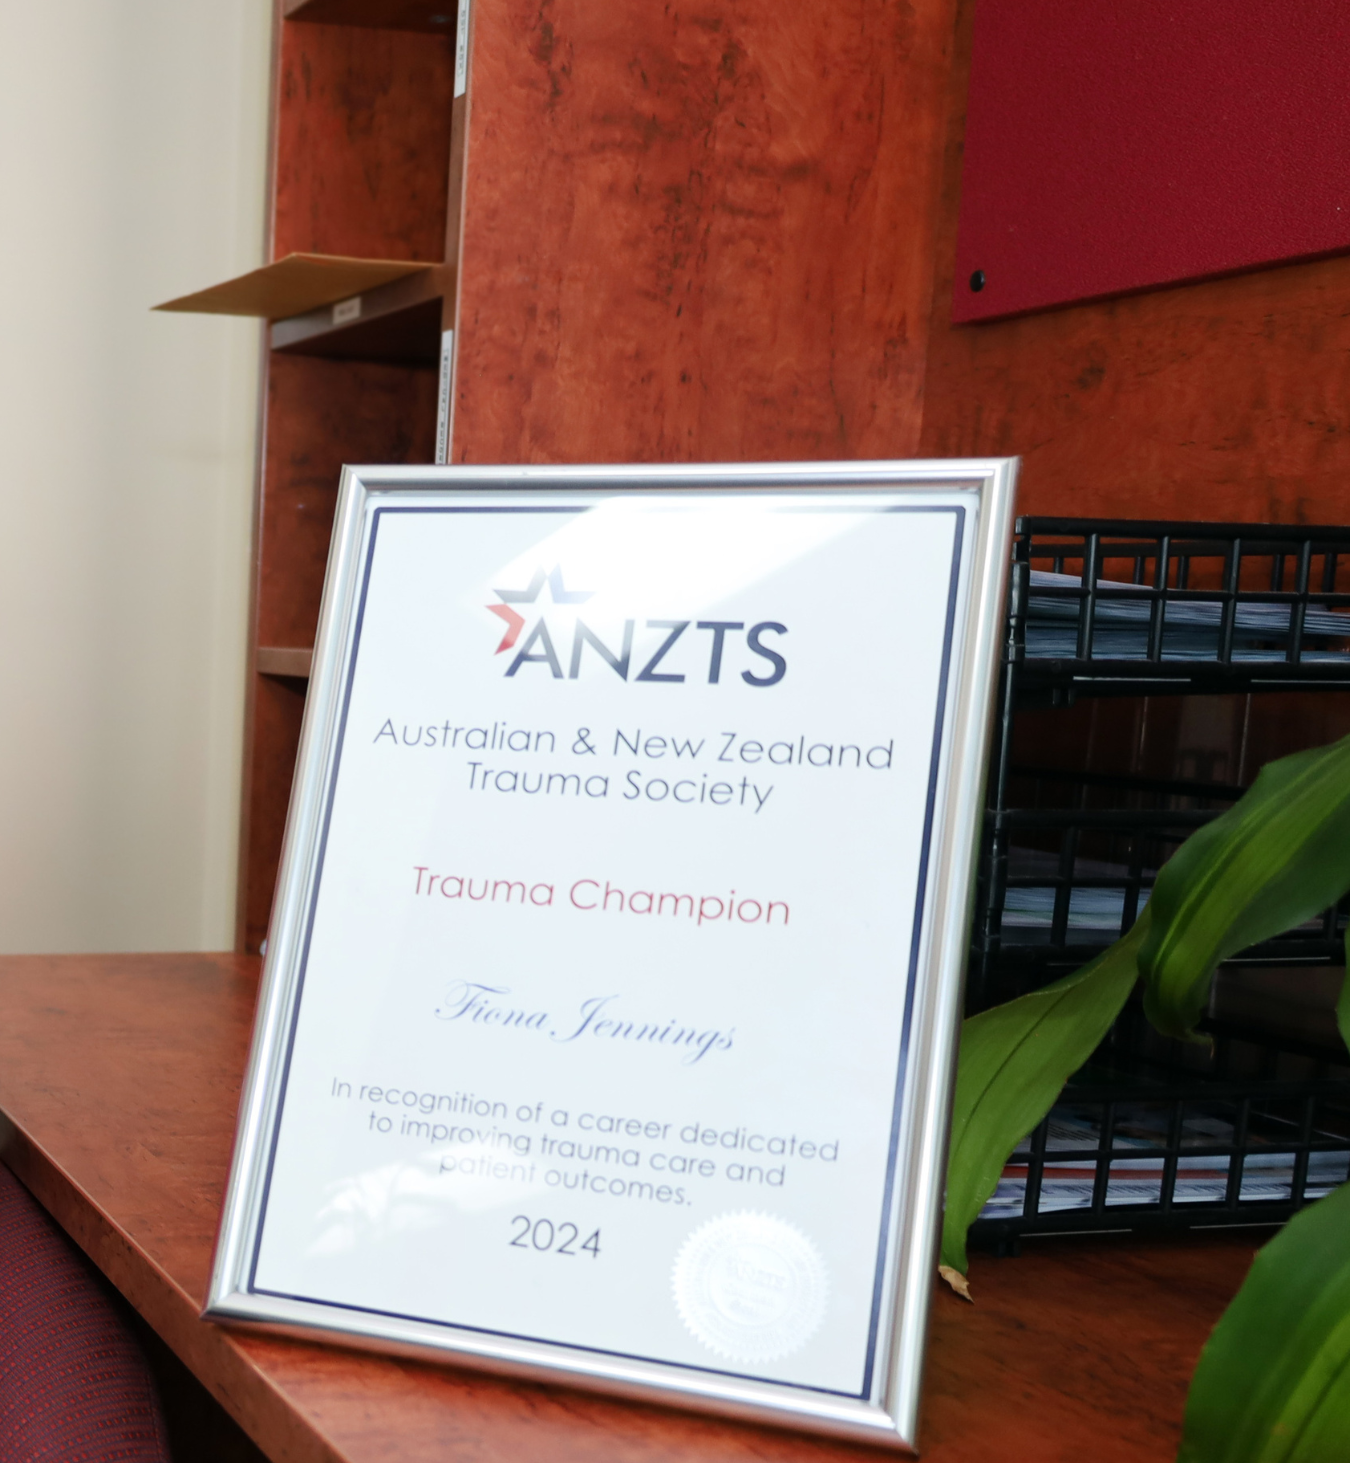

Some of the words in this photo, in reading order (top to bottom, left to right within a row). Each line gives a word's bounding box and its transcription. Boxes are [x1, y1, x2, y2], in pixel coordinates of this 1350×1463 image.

[503, 615, 789, 688] ANZTS
[373, 717, 556, 753] Australian
[571, 727, 597, 756] &
[613, 728, 706, 760] New
[717, 732, 895, 770] Zealand
[467, 761, 610, 798] Trauma
[622, 769, 775, 814] Society
[413, 866, 555, 906] Trauma
[569, 878, 791, 926] Champion
[434, 979, 548, 1031] Fiona
[549, 994, 736, 1067] Jennings
[331, 1076, 352, 1099] In
[358, 1084, 509, 1119] recognition
[515, 1101, 544, 1124] of
[550, 1109, 570, 1127] a
[577, 1112, 672, 1140] career
[679, 1122, 840, 1162] dedicated
[368, 1110, 393, 1134] to
[400, 1113, 532, 1157] improving
[540, 1133, 641, 1167] trauma
[649, 1152, 717, 1178] care
[725, 1163, 787, 1187] and
[439, 1154, 537, 1183] patient
[544, 1168, 693, 1207] outcomes.
[508, 1214, 602, 1259] 2024
